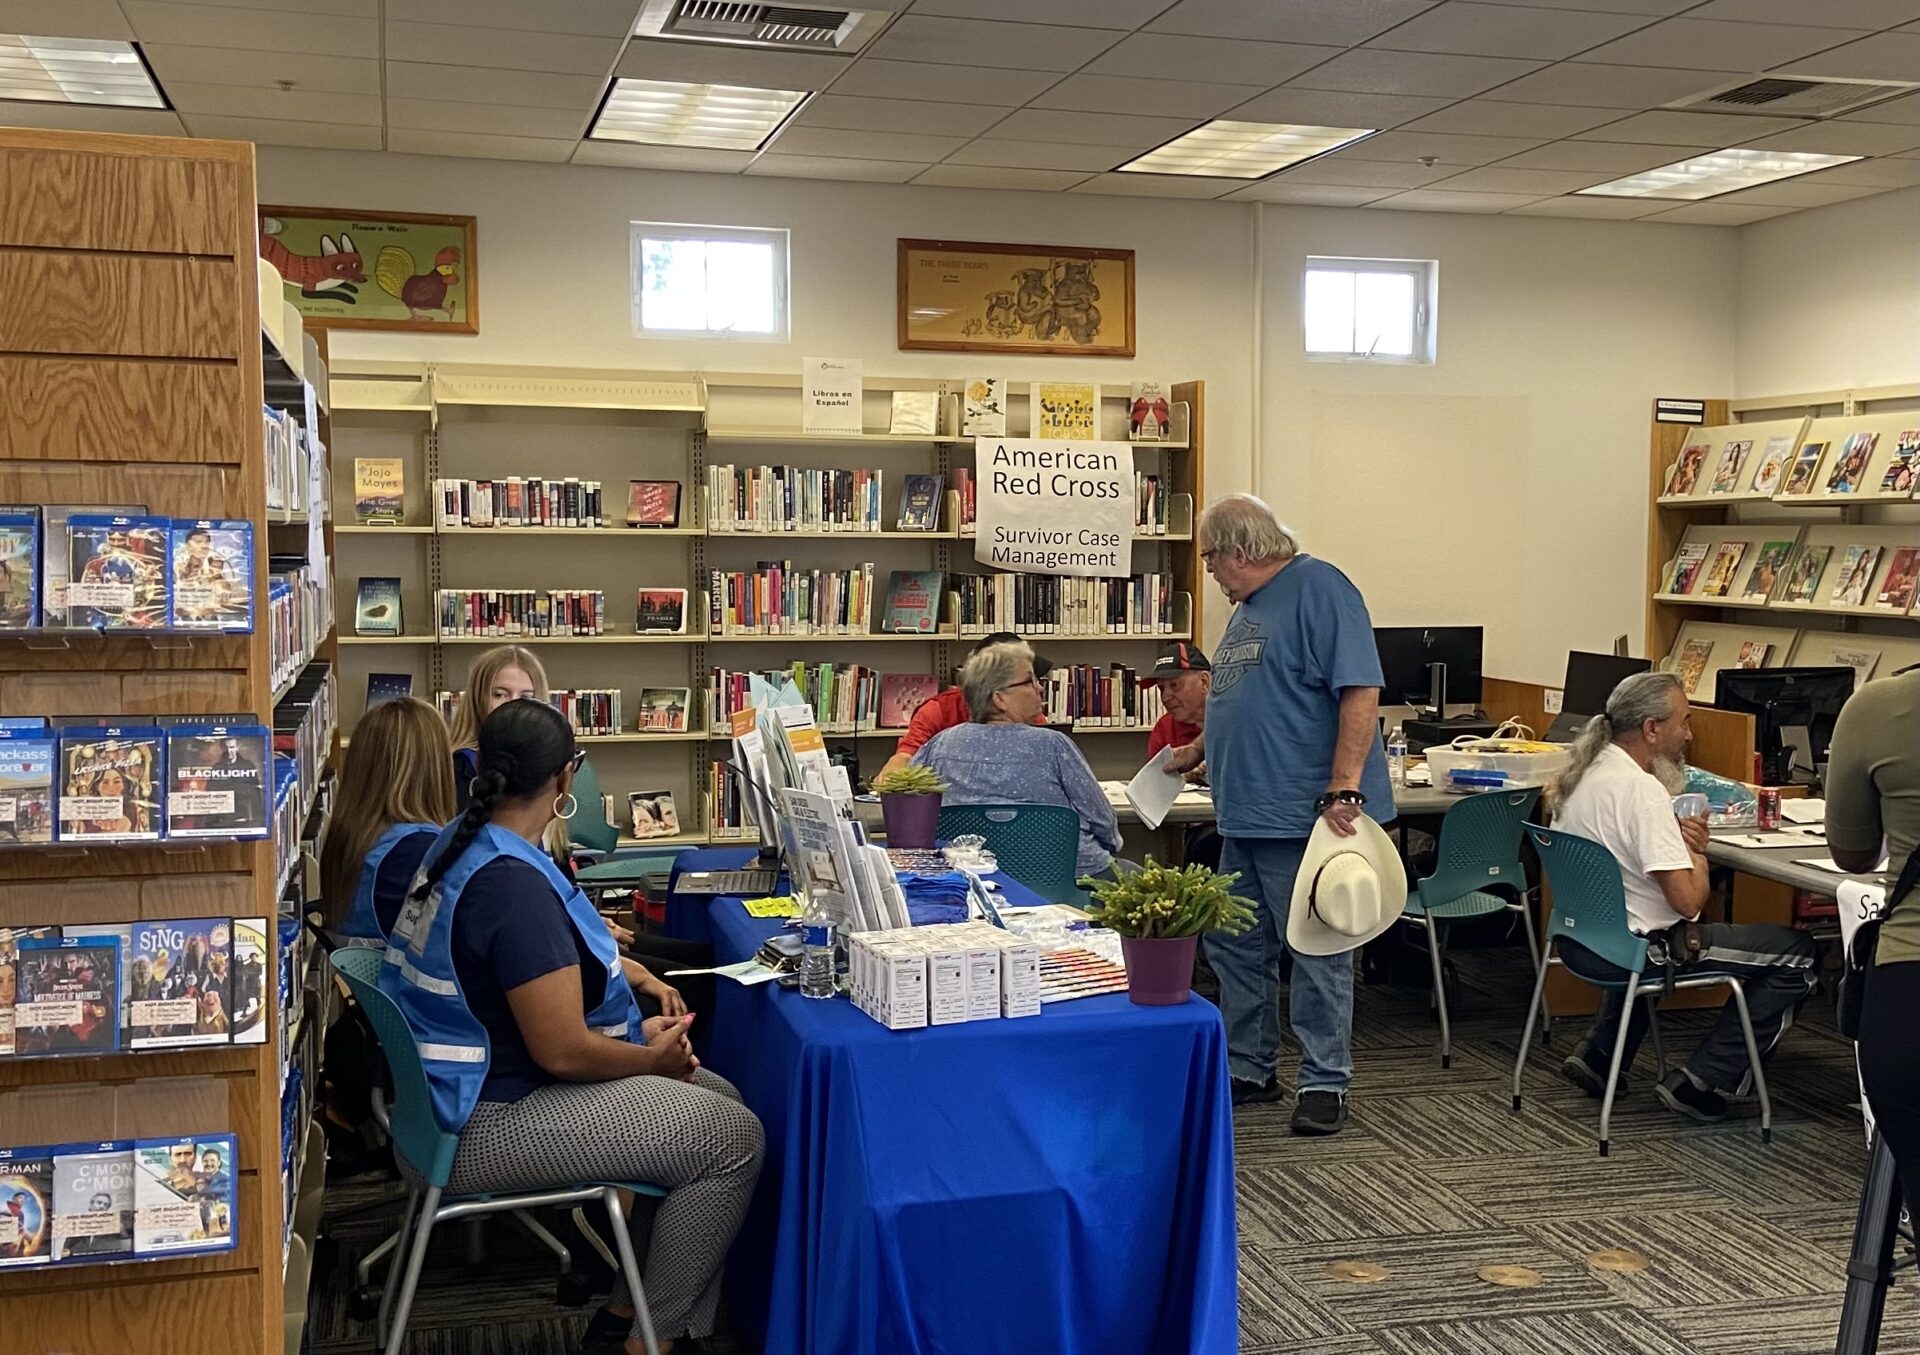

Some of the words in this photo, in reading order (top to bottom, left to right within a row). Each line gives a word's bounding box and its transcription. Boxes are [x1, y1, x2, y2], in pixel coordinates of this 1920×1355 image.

[812, 390, 840, 398] Libros
[816, 399, 849, 407] Español
[1047, 428, 1088, 440] TODOS
[993, 445, 1118, 471] American
[368, 468, 391, 479] Jojo
[362, 479, 398, 489] Moyes
[993, 471, 1041, 495] Red
[1051, 474, 1120, 499] Cross
[994, 526, 1073, 545] Survivor
[1078, 529, 1120, 547] Case
[991, 547, 1117, 569] Management
[711, 570, 721, 609] MARCH
[178, 769, 258, 778] BLACKLIGHT
[140, 929, 185, 952] SING
